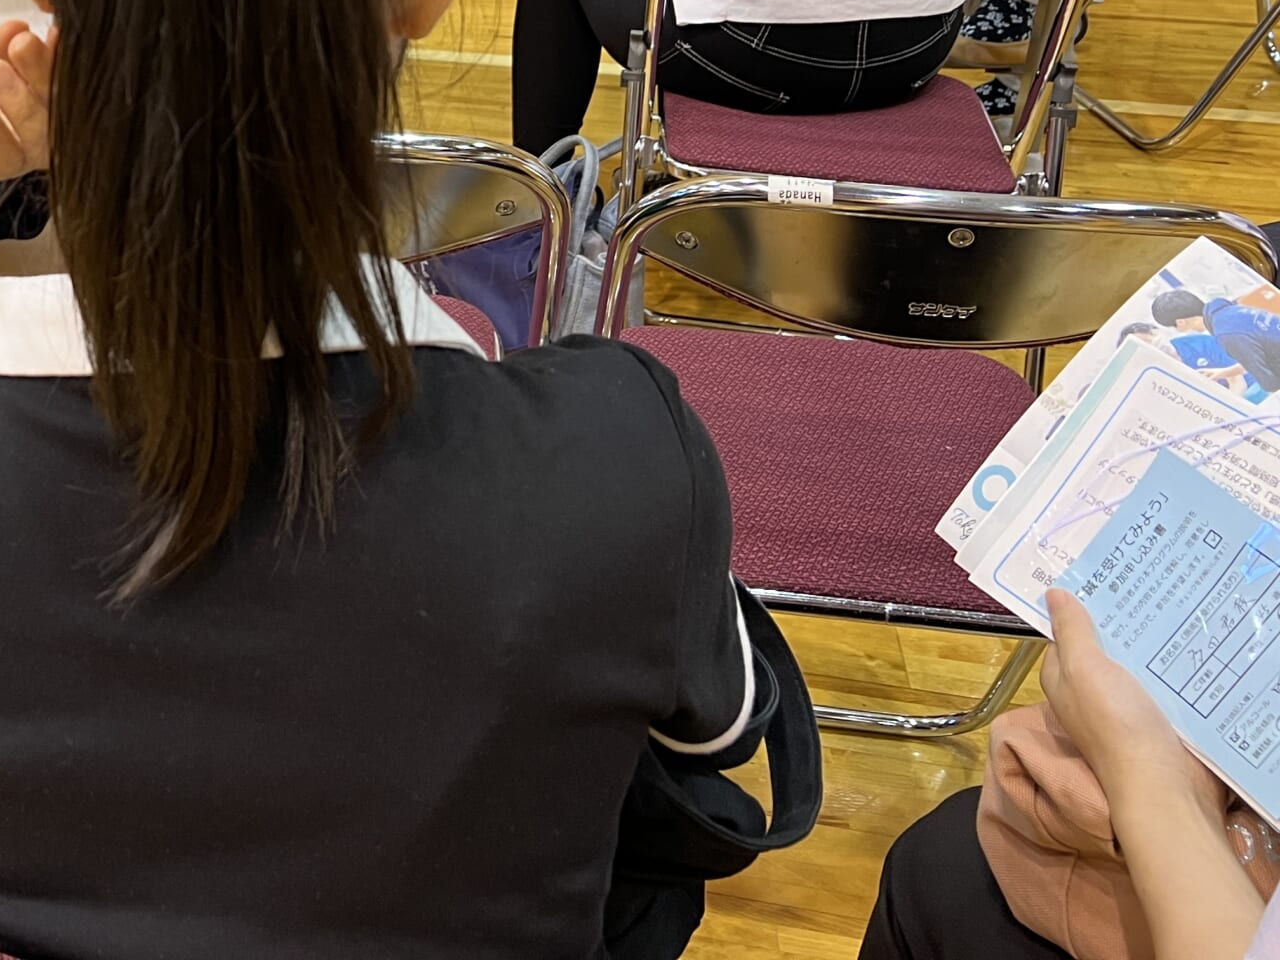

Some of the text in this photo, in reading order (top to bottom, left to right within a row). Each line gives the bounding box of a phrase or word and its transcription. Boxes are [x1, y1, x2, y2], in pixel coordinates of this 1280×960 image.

[1108, 523, 1167, 593] 参加申し込み書
